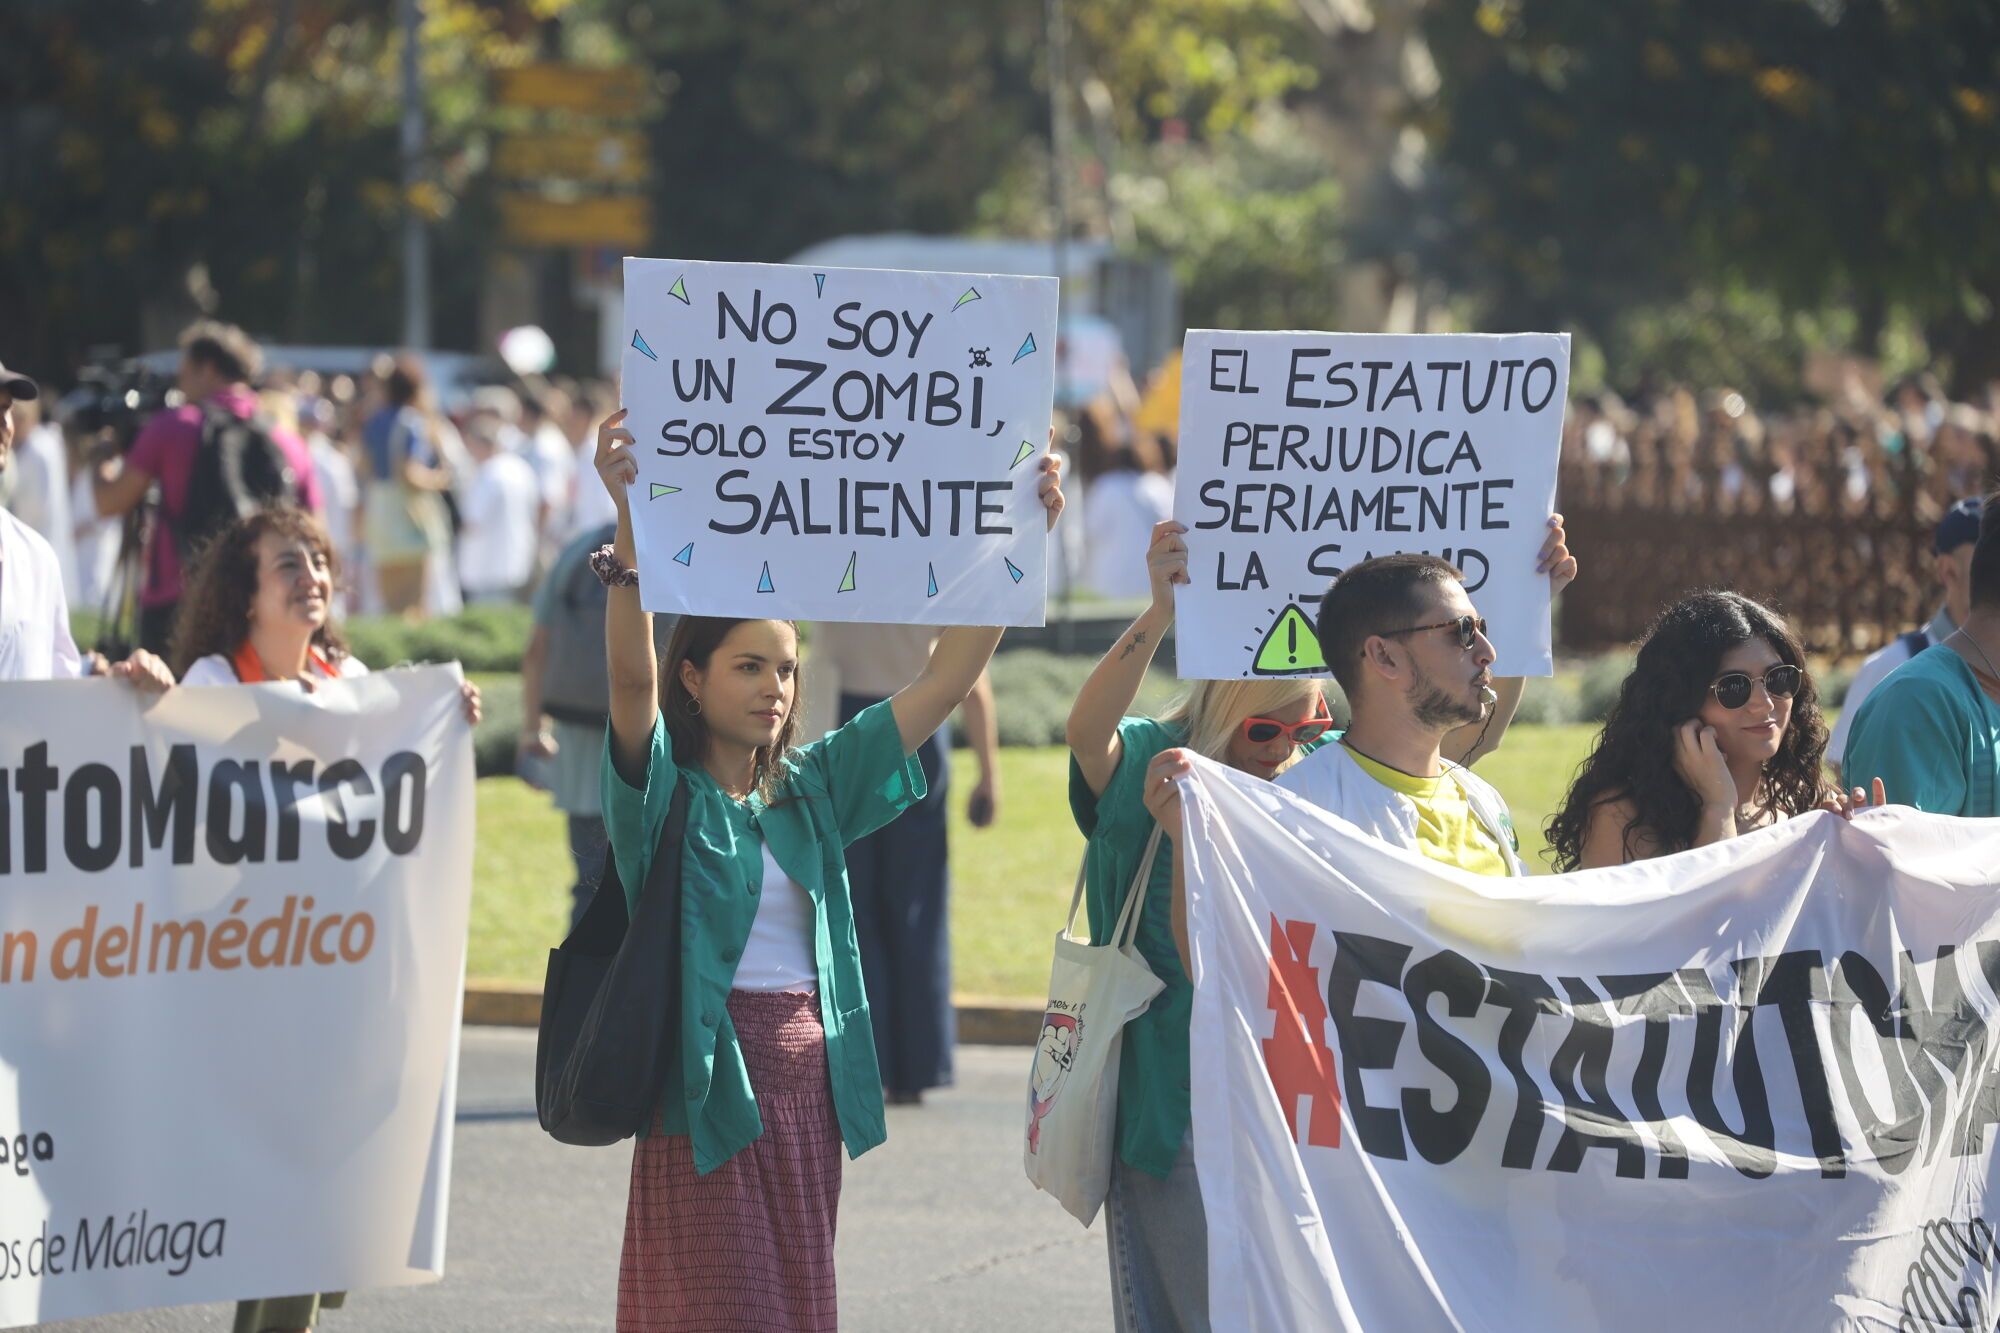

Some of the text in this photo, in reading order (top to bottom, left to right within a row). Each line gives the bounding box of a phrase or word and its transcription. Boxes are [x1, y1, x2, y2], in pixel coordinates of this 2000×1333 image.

[718, 289, 933, 358] NO SOY
[672, 357, 735, 404] UN
[1210, 348, 1558, 414] EL ESTATUTO
[657, 419, 905, 463] SOLO ESTOY
[1222, 421, 1482, 476] PERJUDICA
[708, 469, 1013, 538] SALIENTE
[1195, 478, 1514, 534] SERIAMENTE
[1216, 551, 1269, 591] LA
[0, 739, 428, 875] toMarco
[50, 903, 144, 982] del
[148, 895, 375, 974] médico
[28, 1220, 66, 1276] de
[72, 1209, 226, 1276] Málaga
